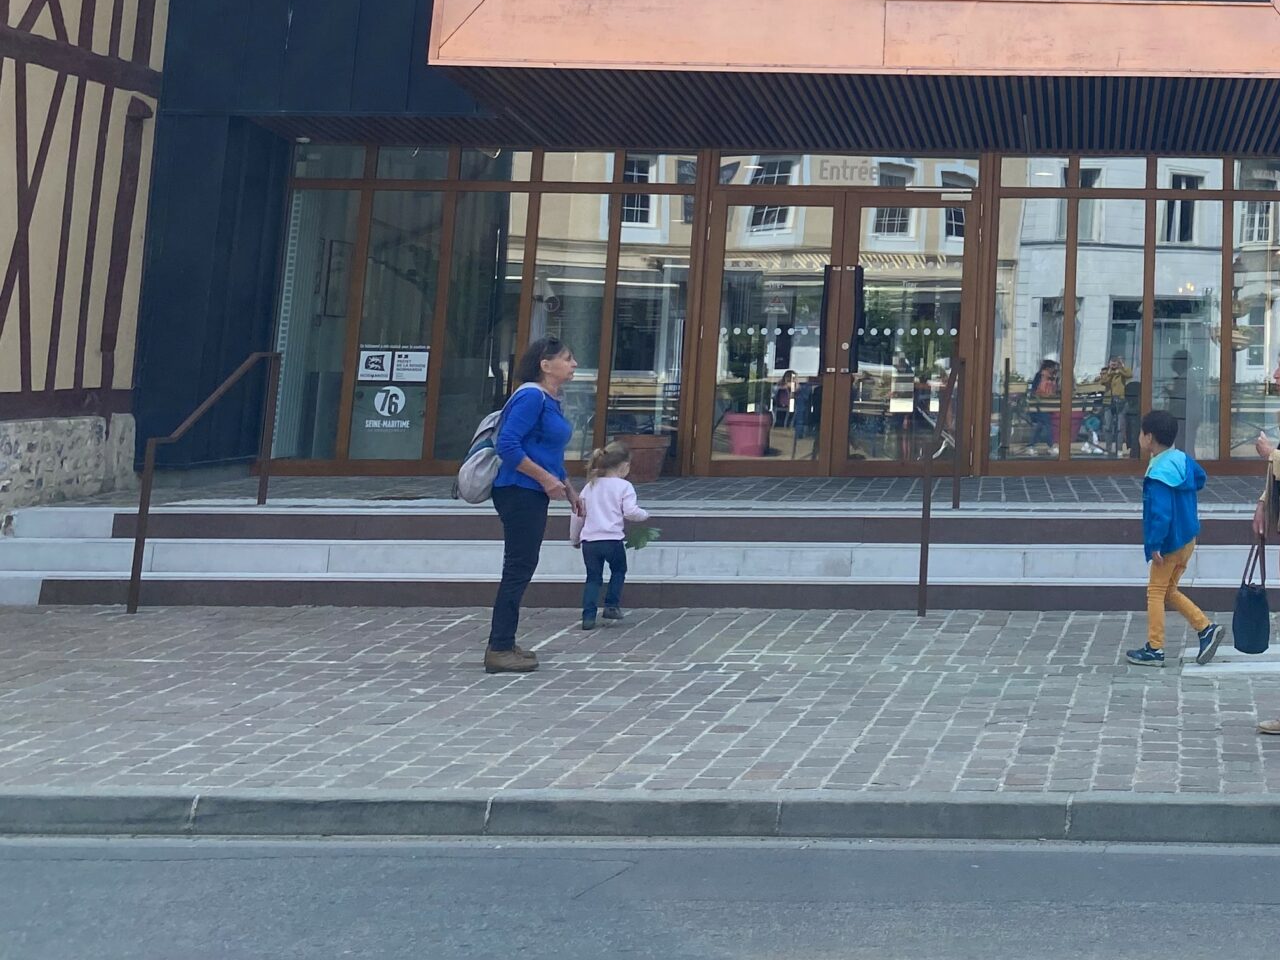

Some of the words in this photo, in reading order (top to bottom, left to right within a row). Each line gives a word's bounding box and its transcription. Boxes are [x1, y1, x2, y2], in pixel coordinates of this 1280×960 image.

[818, 159, 880, 181] Entrée
[378, 389, 400, 416] 76
[364, 419, 410, 429] SEINE-MARITIME
